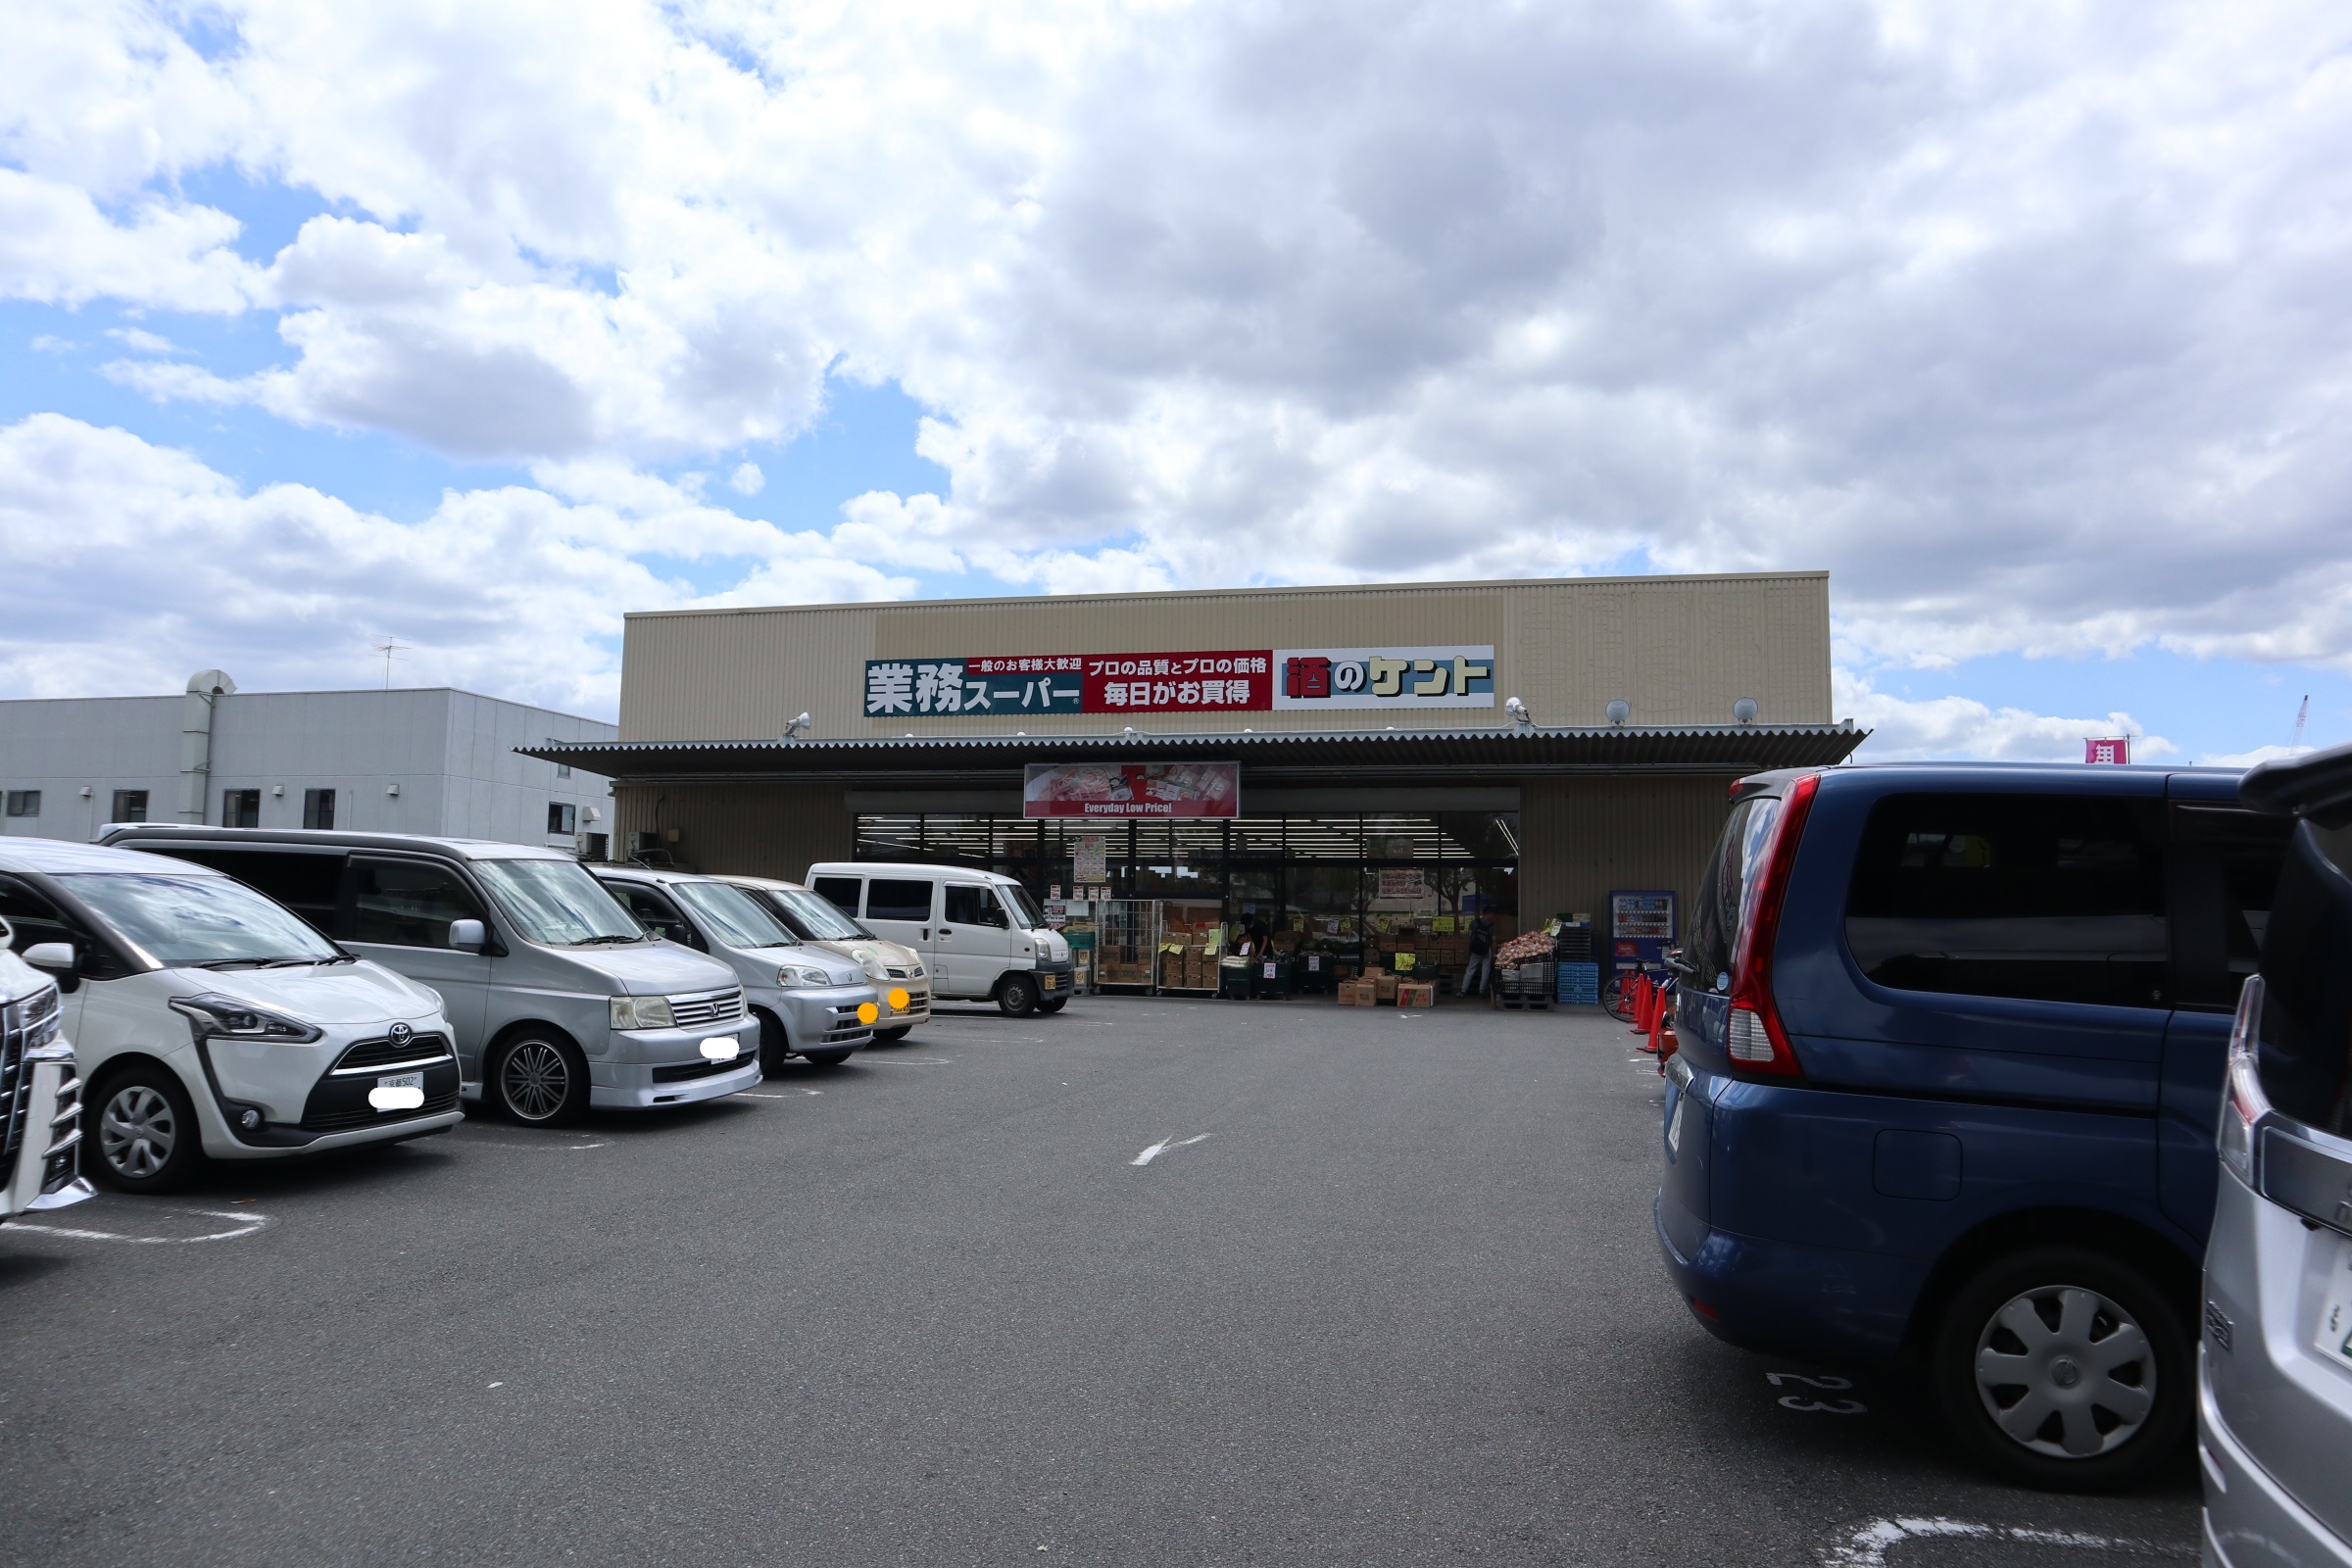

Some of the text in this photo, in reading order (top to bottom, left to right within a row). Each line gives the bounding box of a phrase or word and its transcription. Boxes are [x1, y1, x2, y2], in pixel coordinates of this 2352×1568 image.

[968, 658, 1082, 672] 一般のお客様大歓迎
[1089, 657, 1267, 676] プロの品質とプロの価格
[866, 662, 1080, 713] 業務スーパー
[1286, 655, 1492, 699] 酒のケント
[1103, 679, 1250, 707] 毎日がお買得
[1084, 803, 1172, 813] Everyday Low Price!
